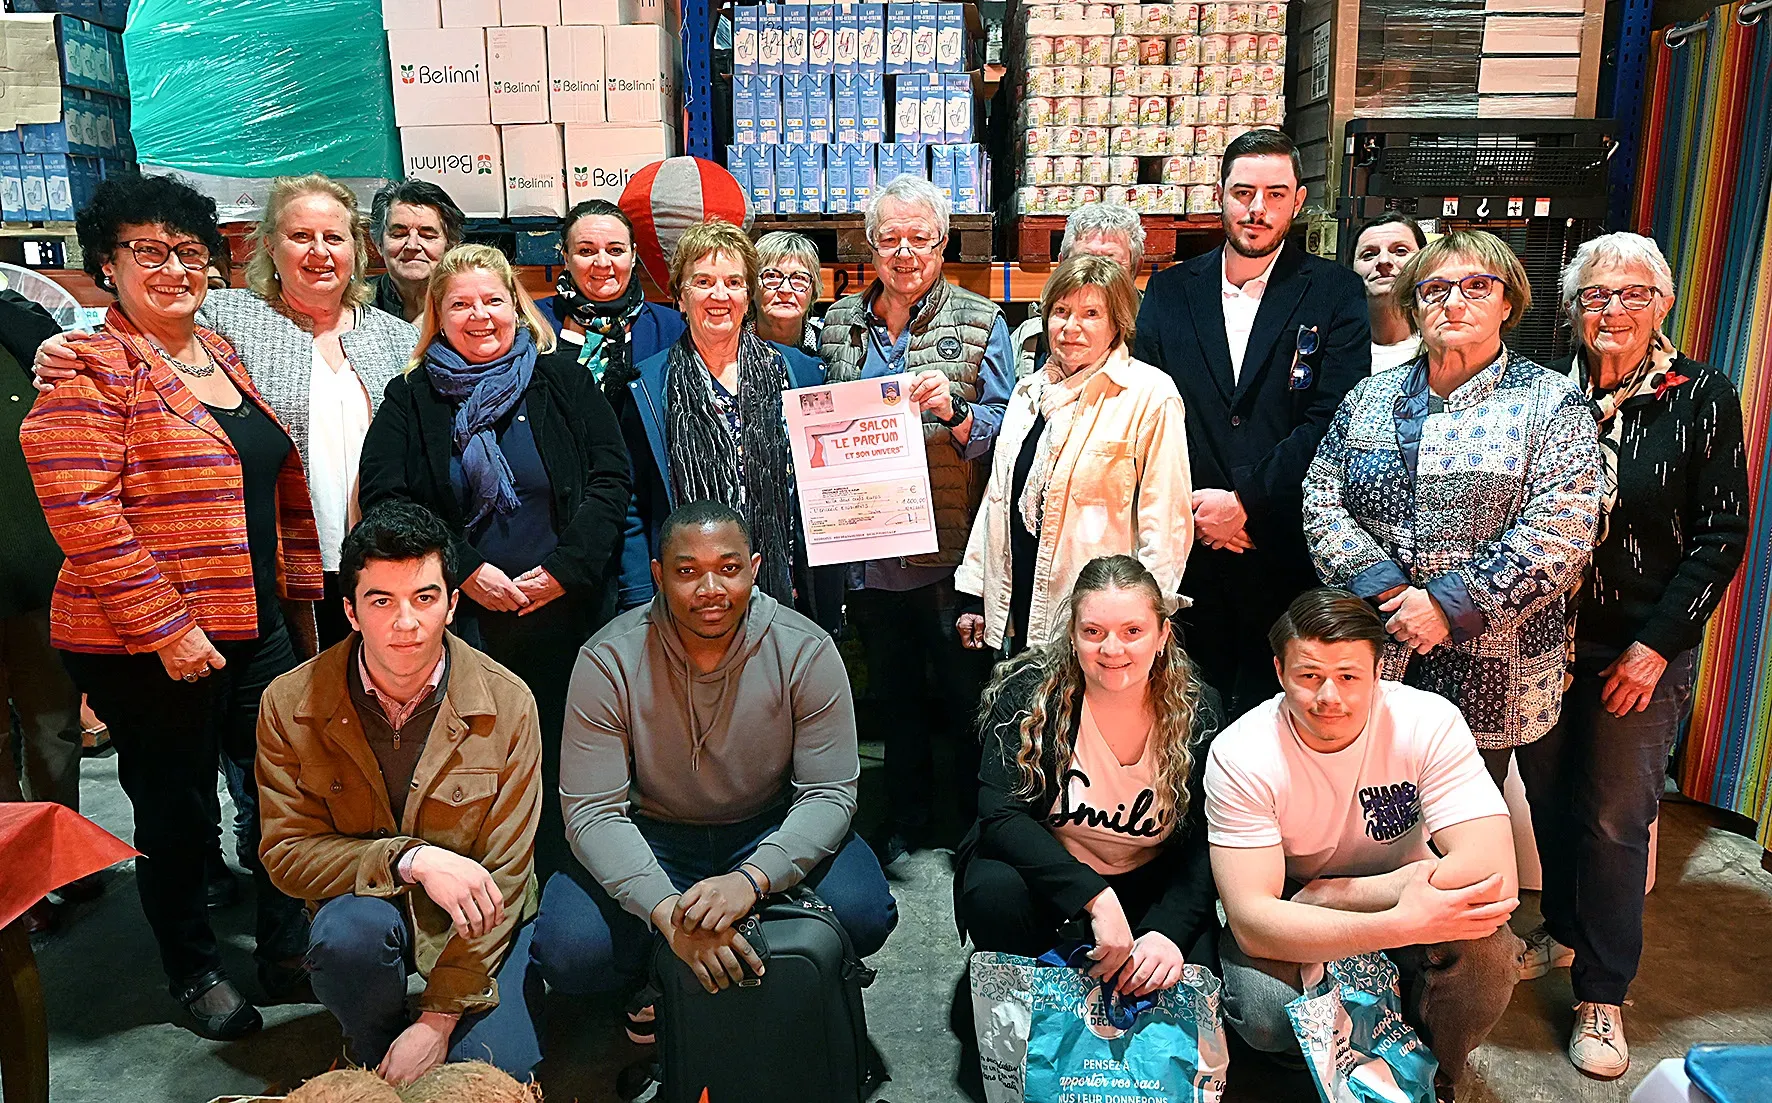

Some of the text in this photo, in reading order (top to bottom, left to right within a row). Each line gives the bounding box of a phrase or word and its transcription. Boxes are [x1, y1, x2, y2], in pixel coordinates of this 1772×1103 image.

[419, 63, 479, 84] Belinni
[503, 80, 540, 93] Belinni
[563, 79, 600, 92] Belinni
[618, 78, 656, 91] Belinni
[410, 154, 473, 176] Belinni
[518, 176, 554, 189] Belinni
[592, 168, 635, 187] Beli
[859, 417, 898, 432] SALON
[852, 431, 899, 447] PARFUM
[845, 452, 855, 460] ET
[855, 450, 870, 458] SON
[1049, 769, 1170, 837] Smile
[1377, 1029, 1402, 1055] NOUS
[1084, 1058, 1121, 1071] PENSEZ
[1060, 1073, 1109, 1092] apporter
[1112, 1079, 1131, 1089] vos
